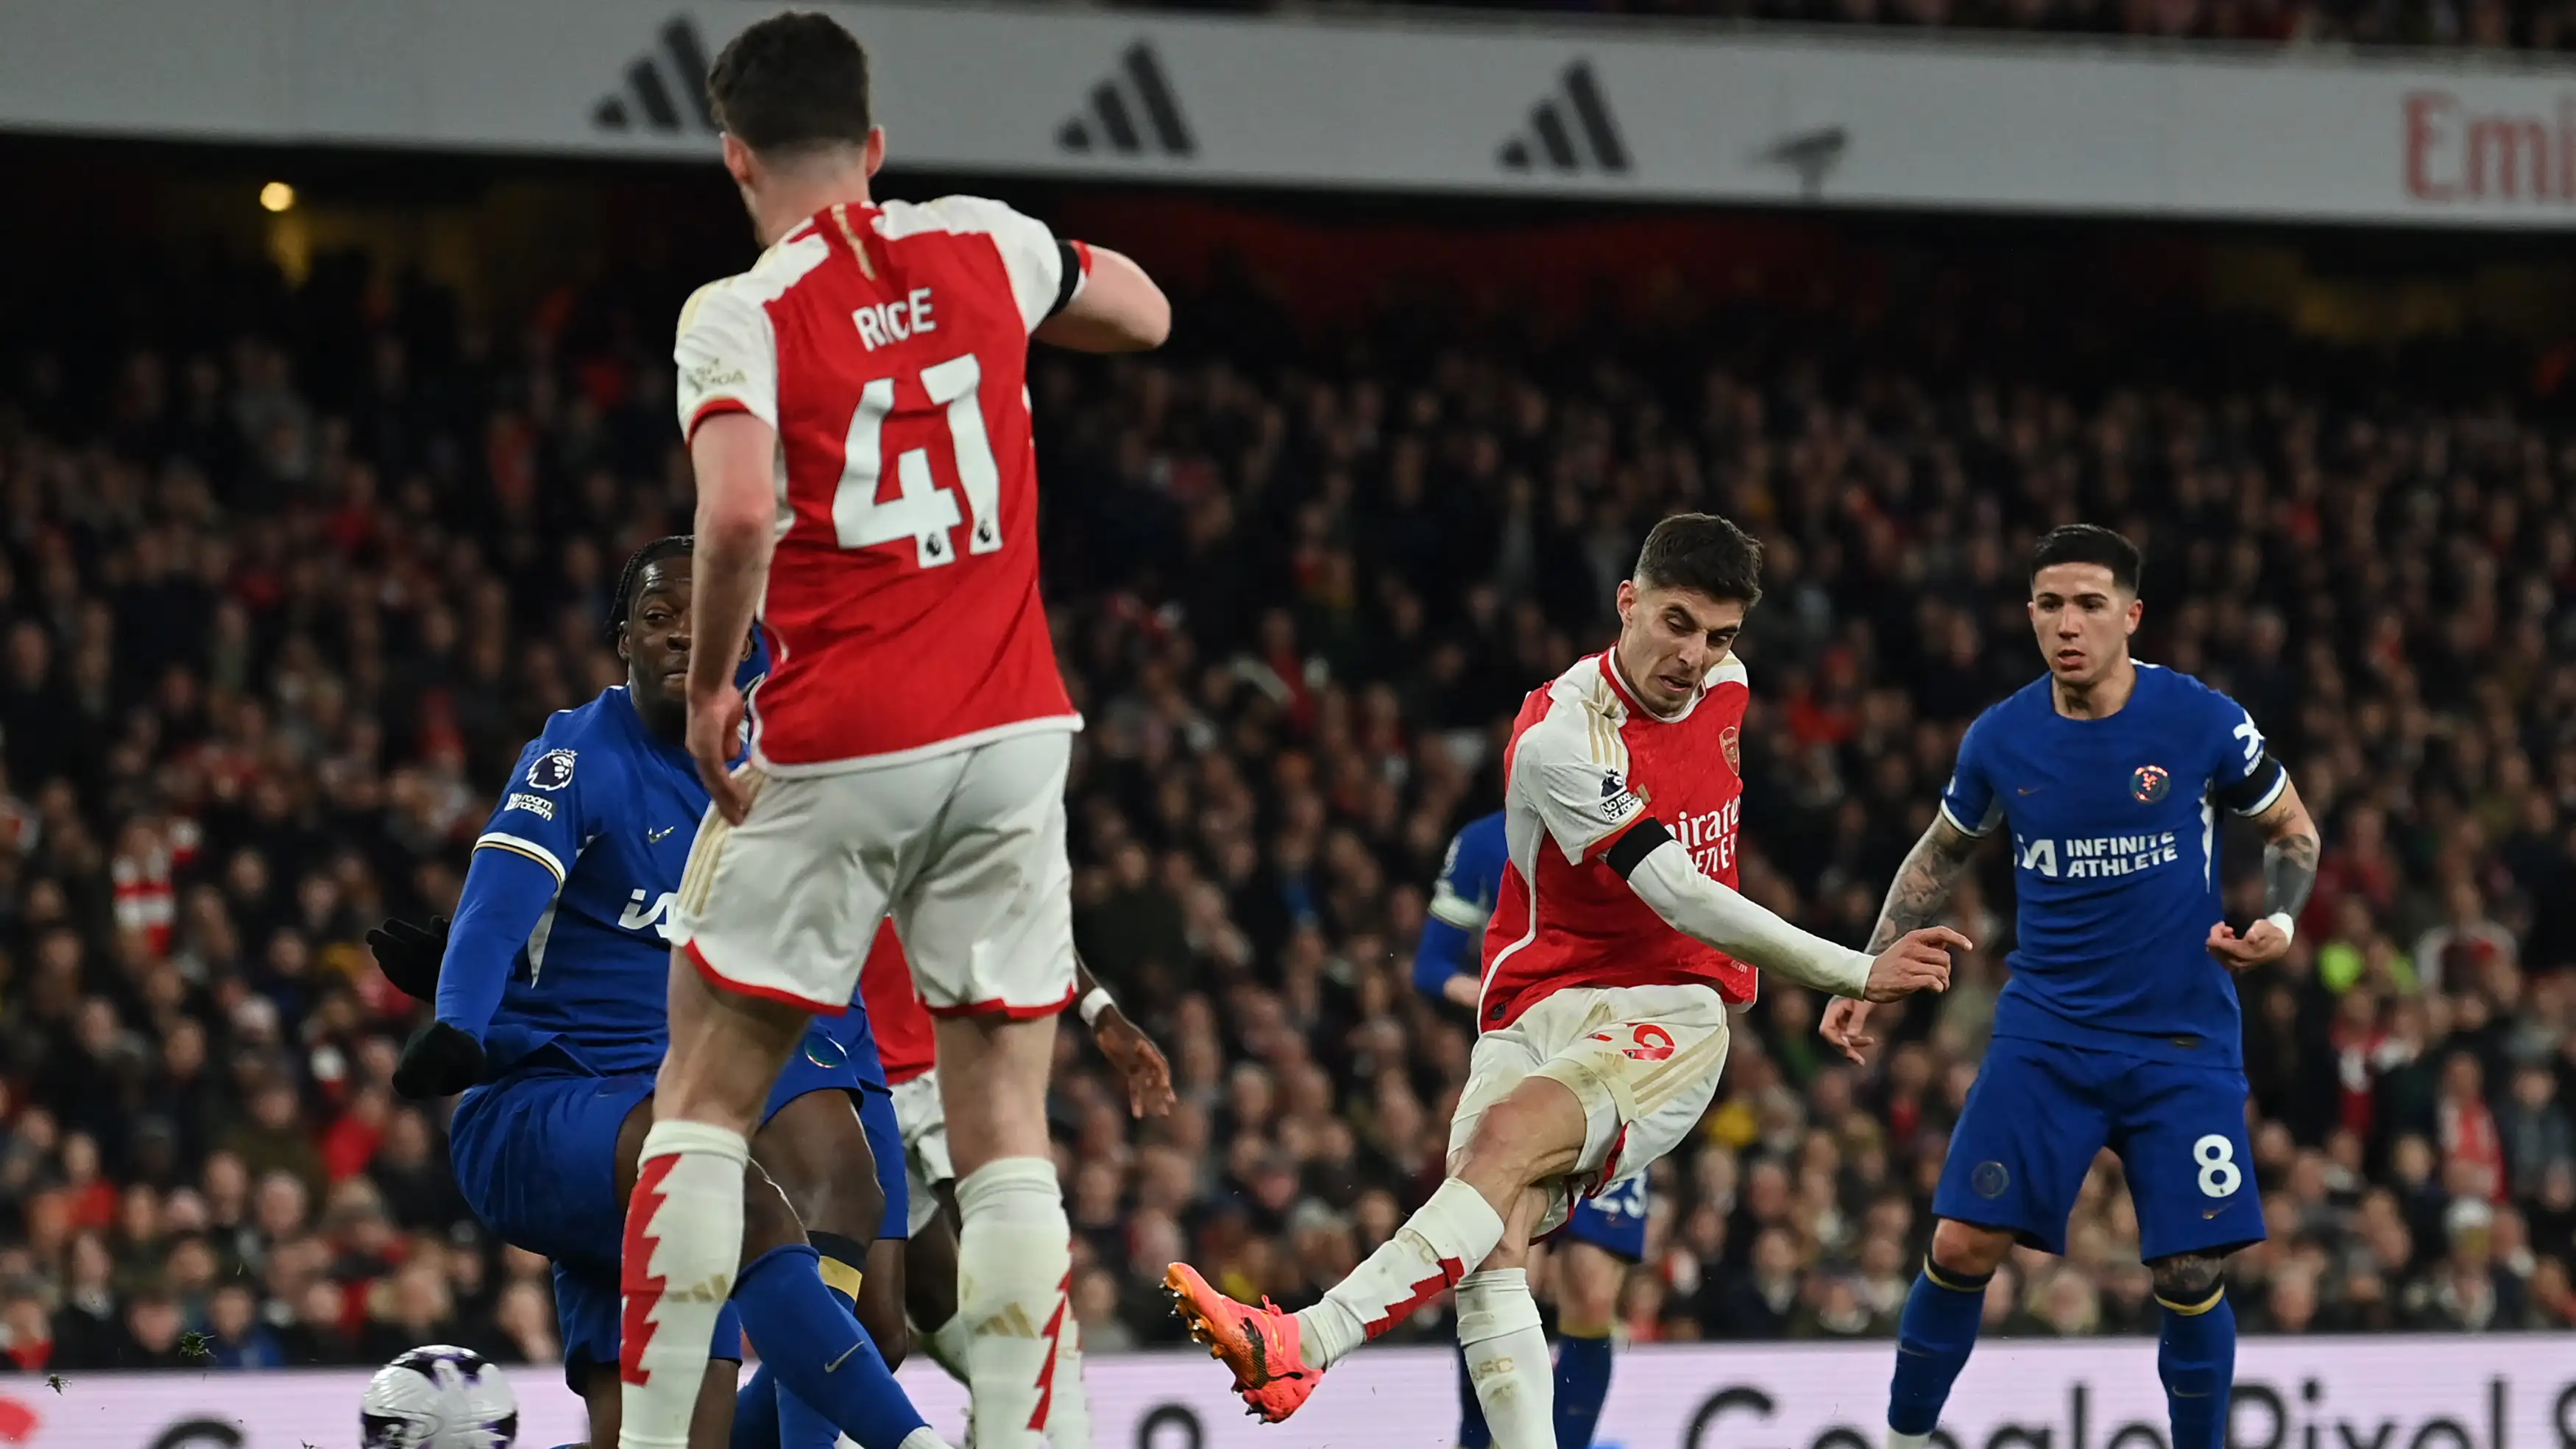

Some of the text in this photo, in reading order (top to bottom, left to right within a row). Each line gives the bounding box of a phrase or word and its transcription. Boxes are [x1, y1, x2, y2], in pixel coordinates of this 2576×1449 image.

[852, 287, 936, 352] RICE
[831, 352, 1003, 569] 41
[521, 794, 553, 811] room
[1600, 800, 1618, 815] No
[2066, 831, 2176, 857] INFINITE
[2067, 843, 2179, 878] ATHLETE
[2193, 1134, 2242, 1198] 8
